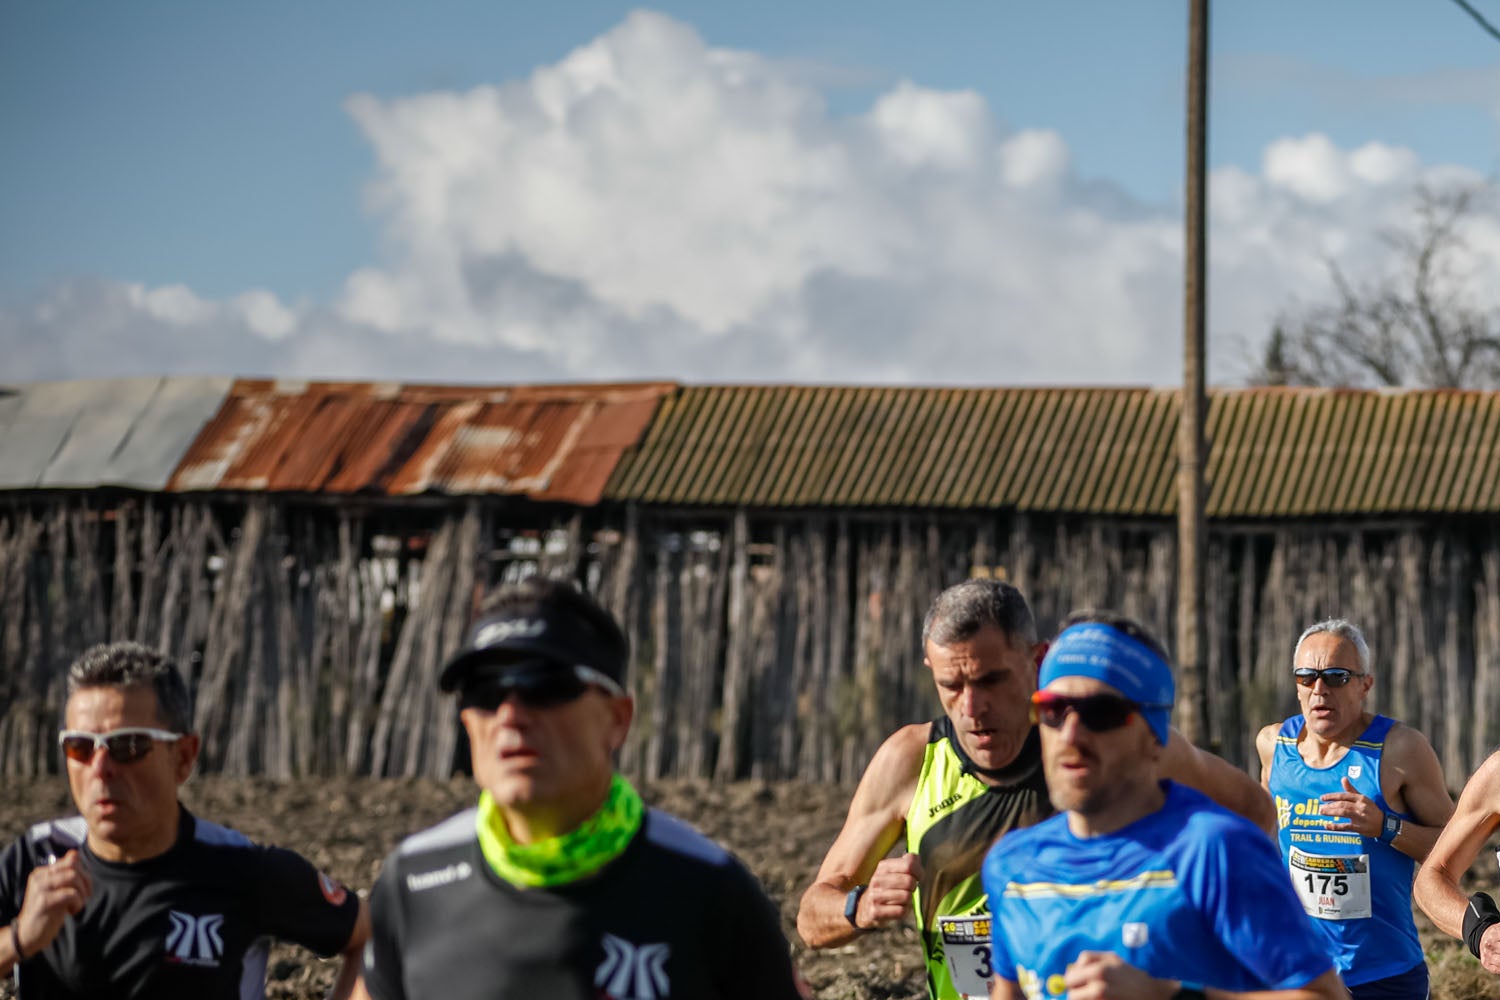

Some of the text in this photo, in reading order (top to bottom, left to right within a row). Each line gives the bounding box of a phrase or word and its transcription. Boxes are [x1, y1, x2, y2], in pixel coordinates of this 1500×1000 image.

[1290, 833, 1362, 845] TRAIL & RUNNING
[1304, 873, 1349, 896] 175
[1319, 897, 1335, 906] JUAN
[972, 945, 993, 979] 3
